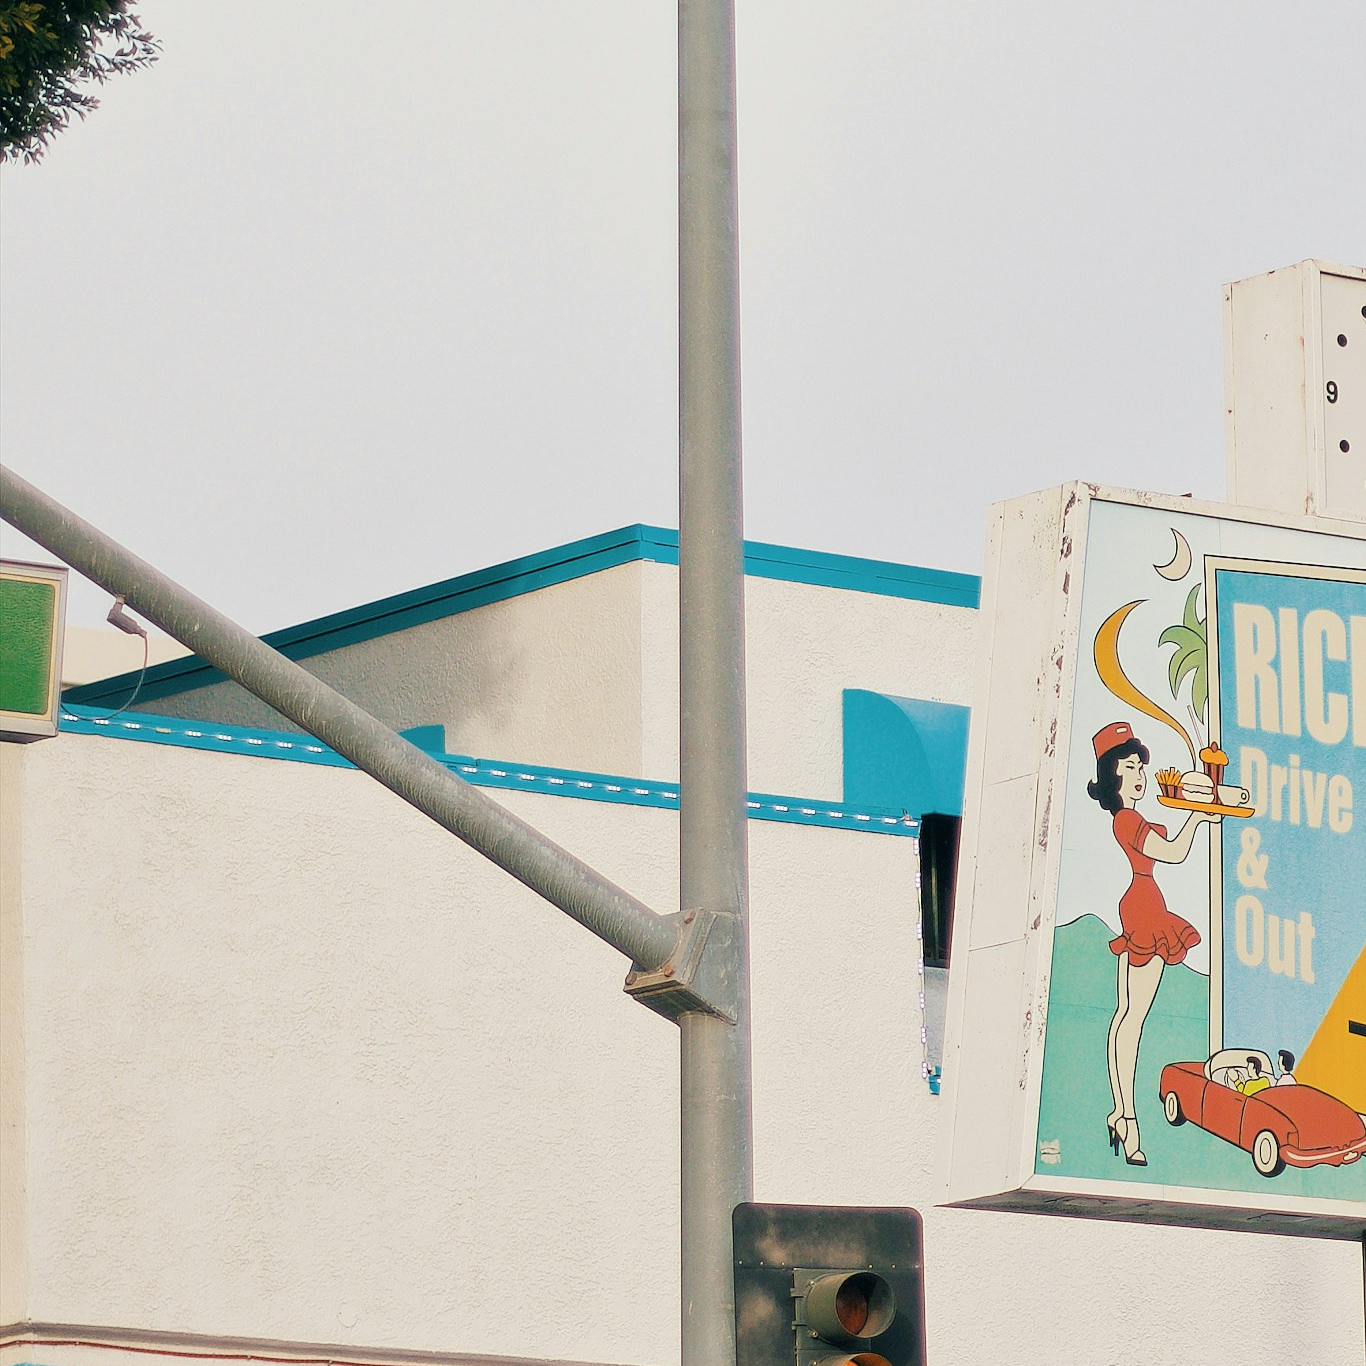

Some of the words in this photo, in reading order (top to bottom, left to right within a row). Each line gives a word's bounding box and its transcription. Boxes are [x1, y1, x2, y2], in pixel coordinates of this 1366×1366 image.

[1326, 381, 1339, 404] 9
[1239, 745, 1354, 835] Drive
[1236, 826, 1268, 891] &
[1235, 895, 1316, 985] Out
